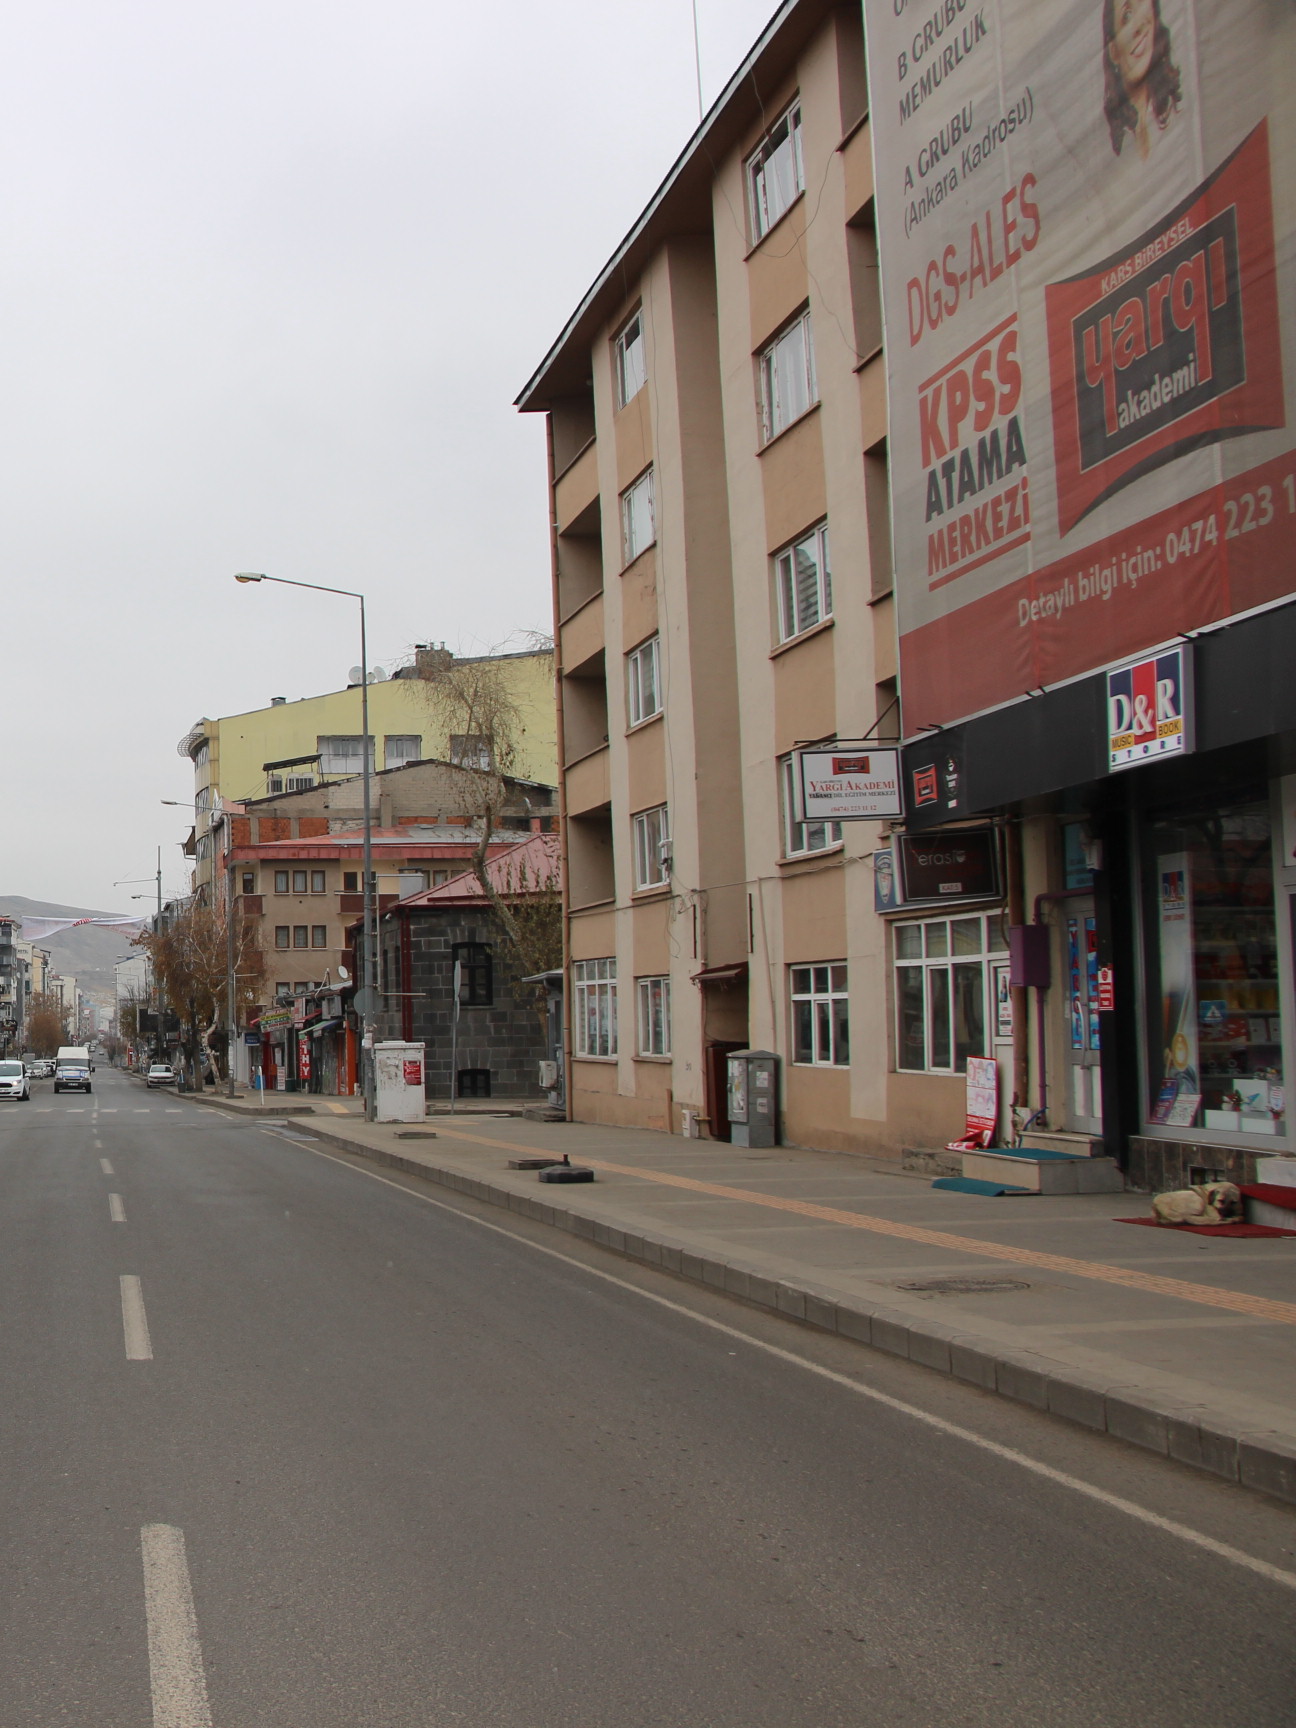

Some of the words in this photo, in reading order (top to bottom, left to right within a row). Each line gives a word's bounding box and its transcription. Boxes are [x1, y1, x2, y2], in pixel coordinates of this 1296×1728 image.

[897, 51, 909, 82] B
[899, 7, 987, 126] MEMURLUK
[903, 165, 914, 195] A
[917, 101, 973, 180] GRUBU
[903, 166, 959, 239] (Ankara
[961, 86, 1034, 180] Kadrosu)
[907, 172, 1042, 347] DGS-ALES
[1101, 264, 1133, 295] KARS
[918, 330, 1022, 469] KPSS
[1118, 353, 1198, 428] akademi
[925, 415, 1027, 523] ATAMA
[1018, 578, 1075, 627] Detaylı
[1078, 556, 1118, 601] bilgi
[1122, 545, 1162, 589] için:
[1165, 514, 1219, 564] 0474
[1223, 485, 1274, 540] 223
[1109, 679, 1177, 736] D&R
[1111, 735, 1133, 749] MUSIC
[1158, 721, 1180, 736] BOOK
[809, 781, 843, 792] YARGI
[1111, 736, 1182, 763] STORE
